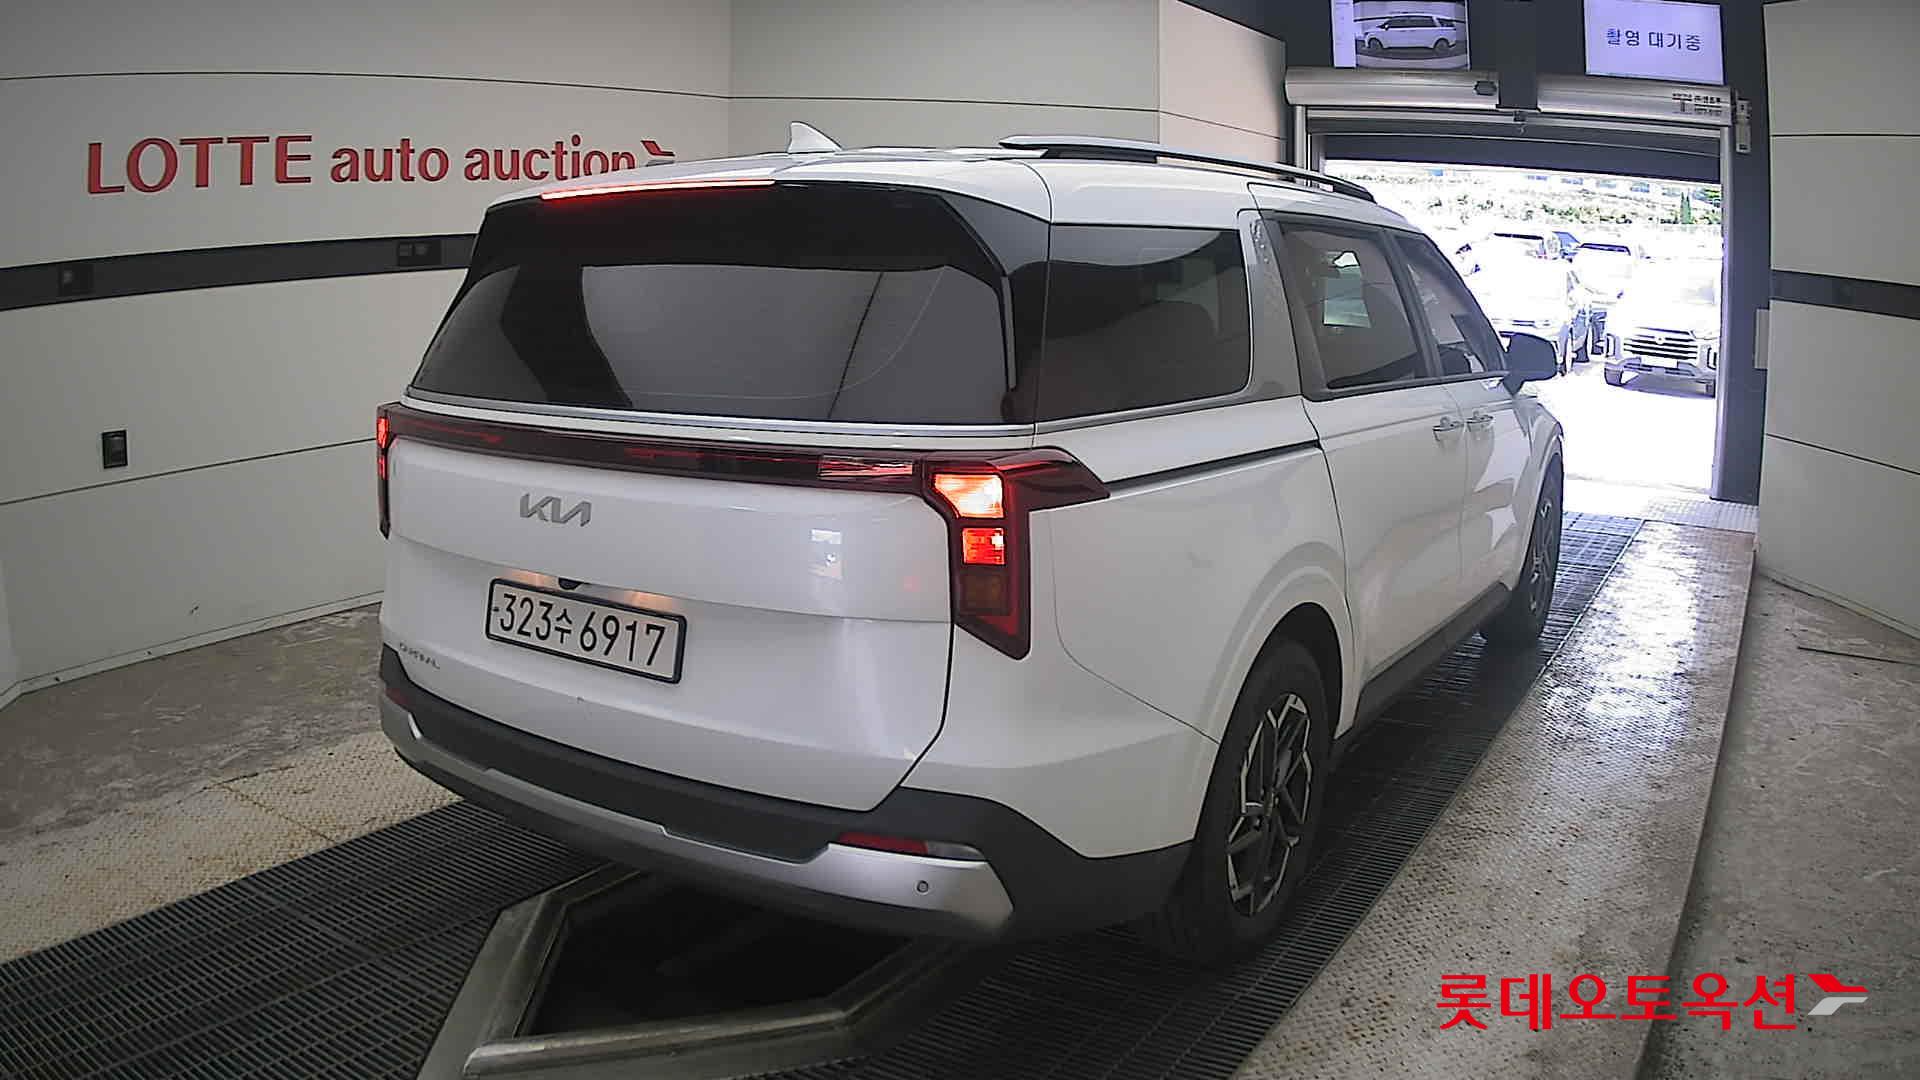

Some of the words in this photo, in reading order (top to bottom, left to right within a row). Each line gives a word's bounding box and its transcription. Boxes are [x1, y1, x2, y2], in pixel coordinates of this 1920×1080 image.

[1648, 31, 1701, 52] 대기중
[87, 135, 311, 194] LOTTE
[330, 138, 453, 183] auto
[464, 134, 636, 182] auction
[519, 492, 593, 527] KIA
